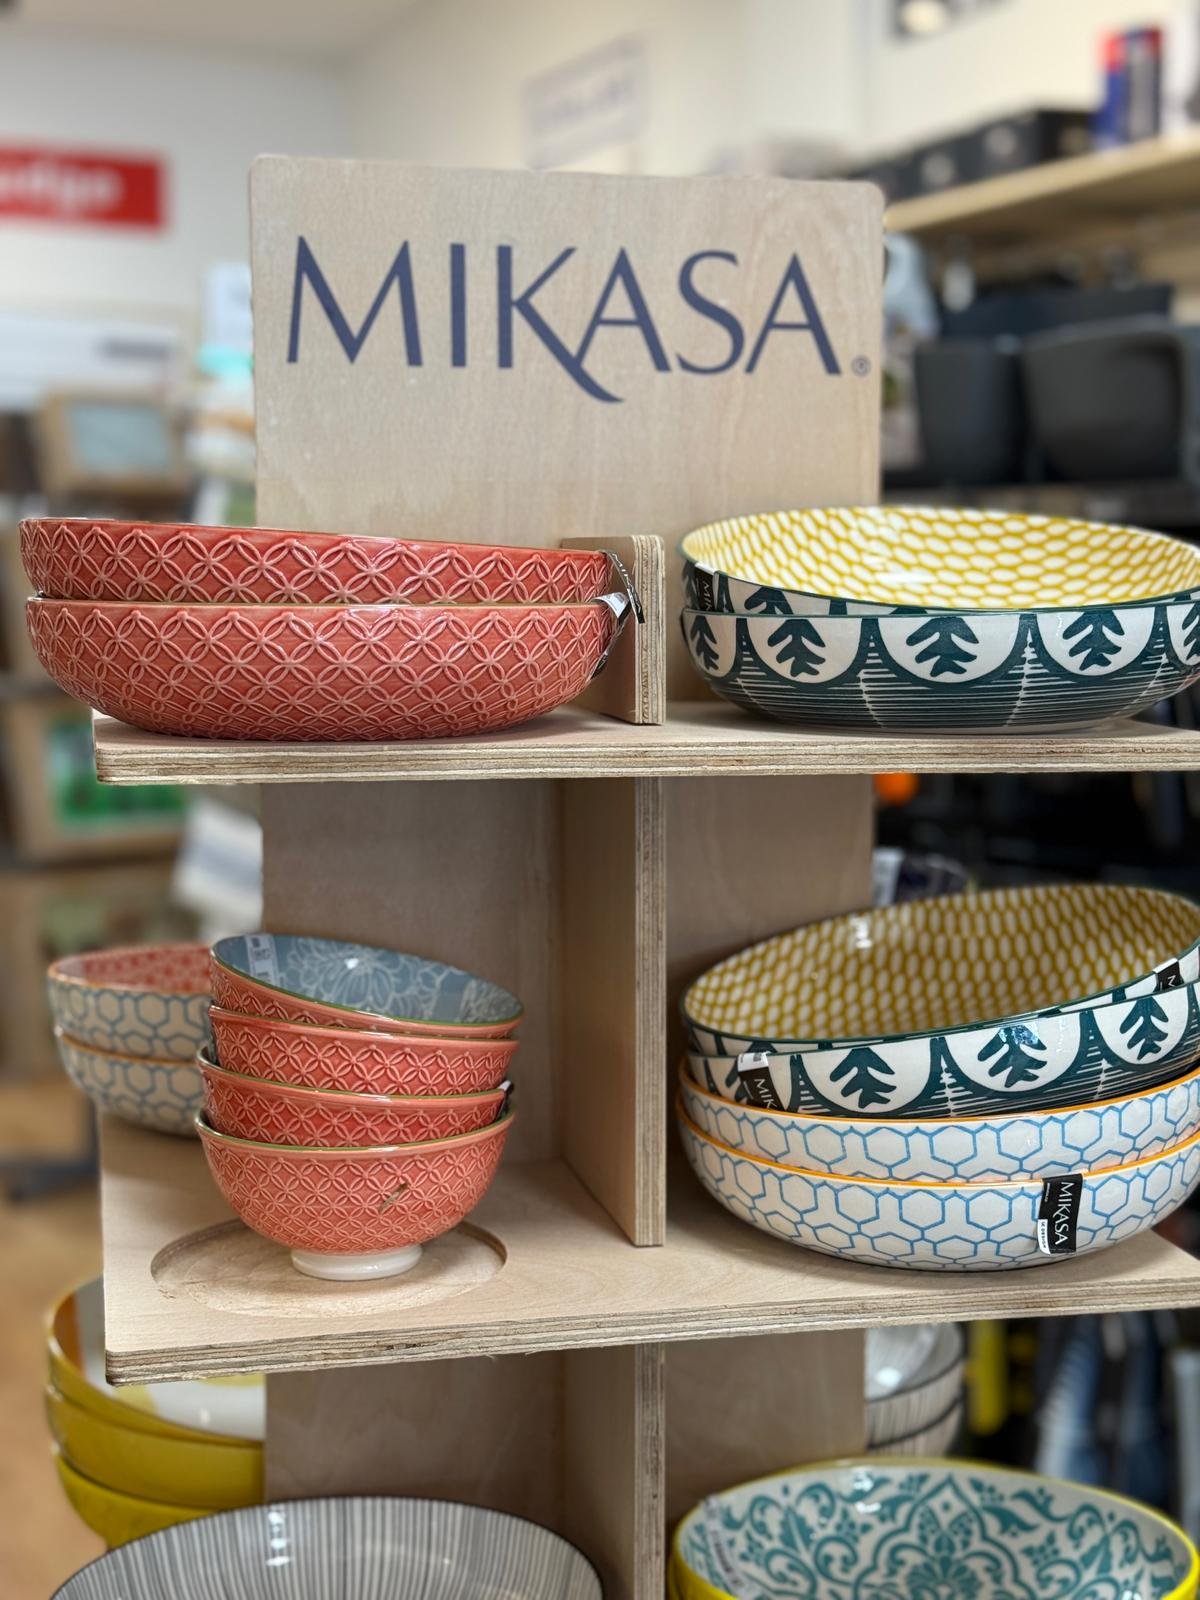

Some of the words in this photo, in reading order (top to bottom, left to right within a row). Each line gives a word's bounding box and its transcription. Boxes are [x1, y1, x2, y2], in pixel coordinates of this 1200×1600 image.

[287, 235, 842, 403] MIKASA
[753, 1078, 778, 1109] MIK
[1052, 1181, 1076, 1246] MIKASA
